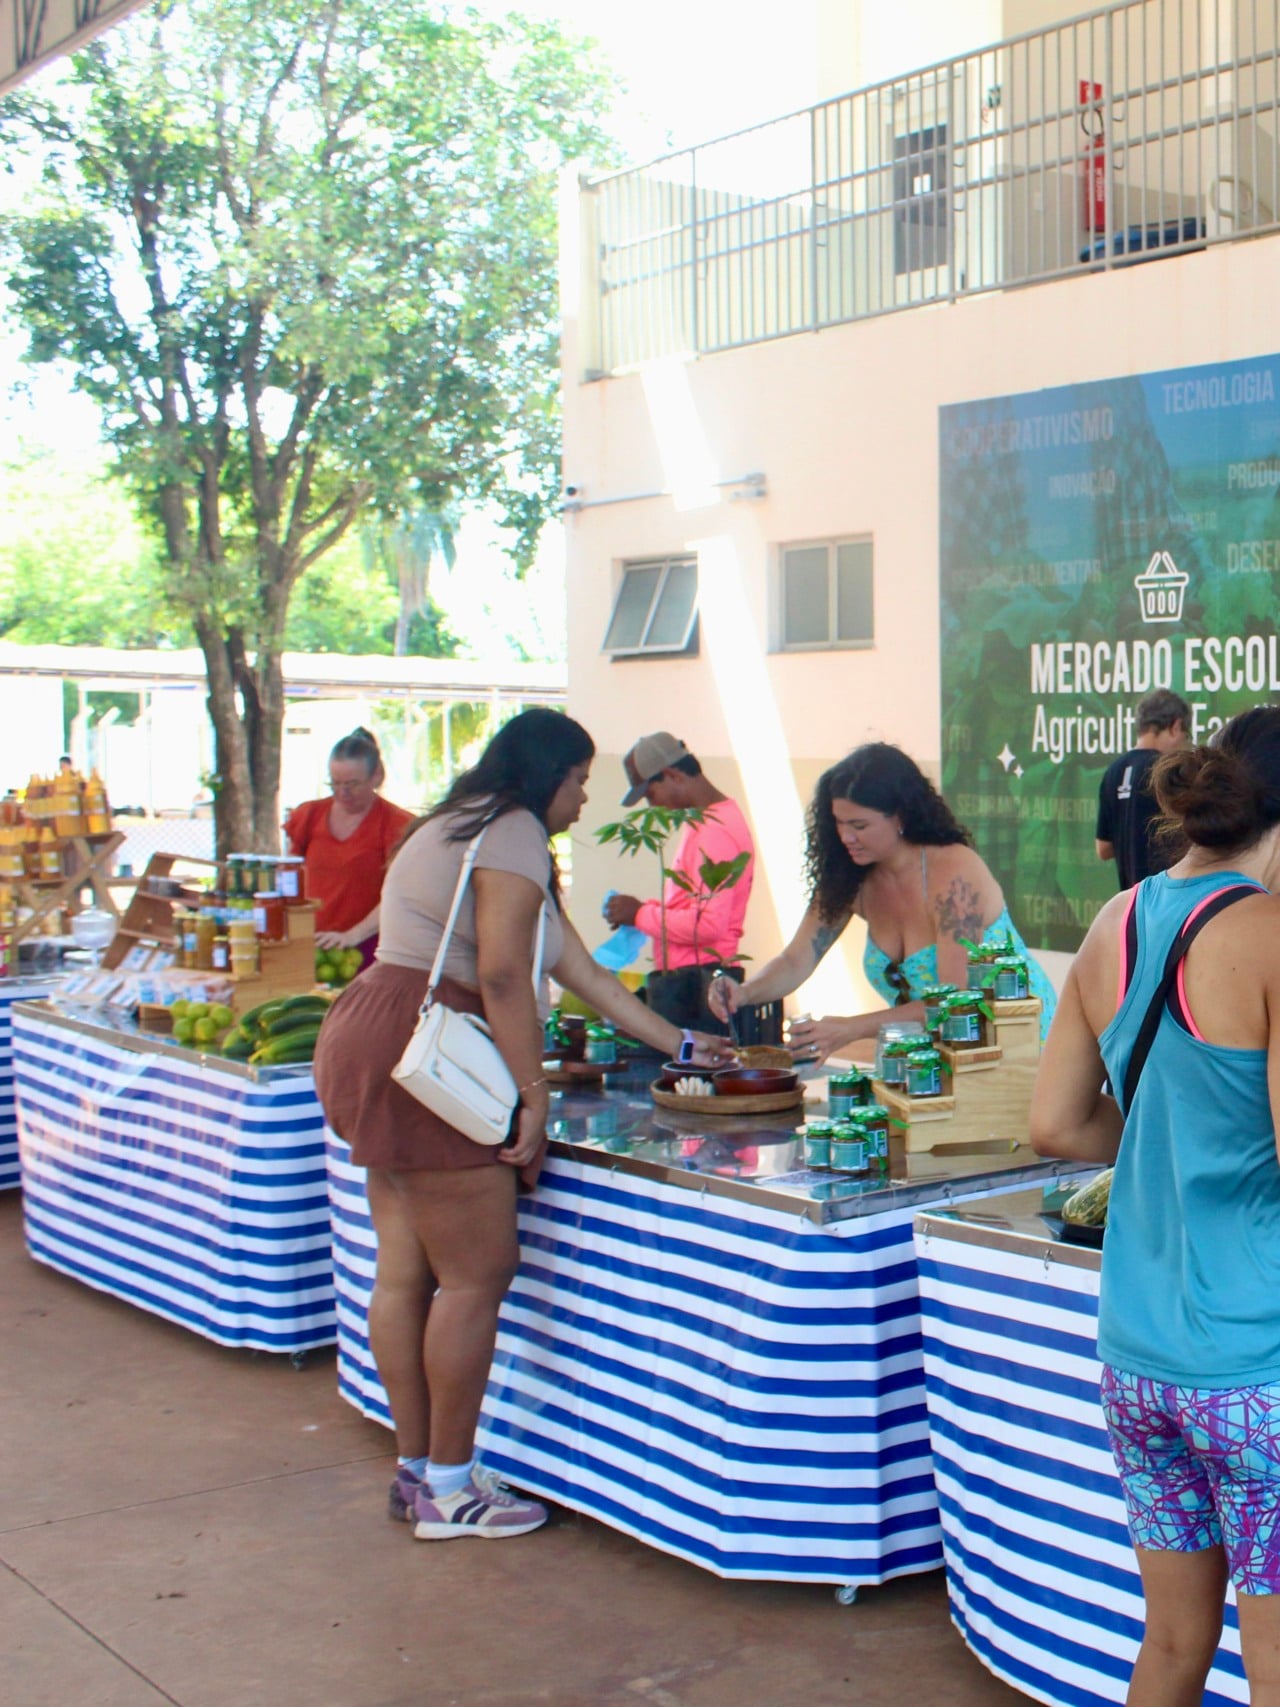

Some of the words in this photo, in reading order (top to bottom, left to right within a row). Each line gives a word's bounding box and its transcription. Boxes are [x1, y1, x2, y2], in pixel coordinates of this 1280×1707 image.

[1162, 369, 1275, 414] TECNOLOGIA
[951, 407, 1114, 456] COOPERATIVISMO
[1048, 466, 1116, 502] INOVAÇÃO
[1030, 638, 1172, 693] MERCADO
[1031, 703, 1135, 763] Agricult
